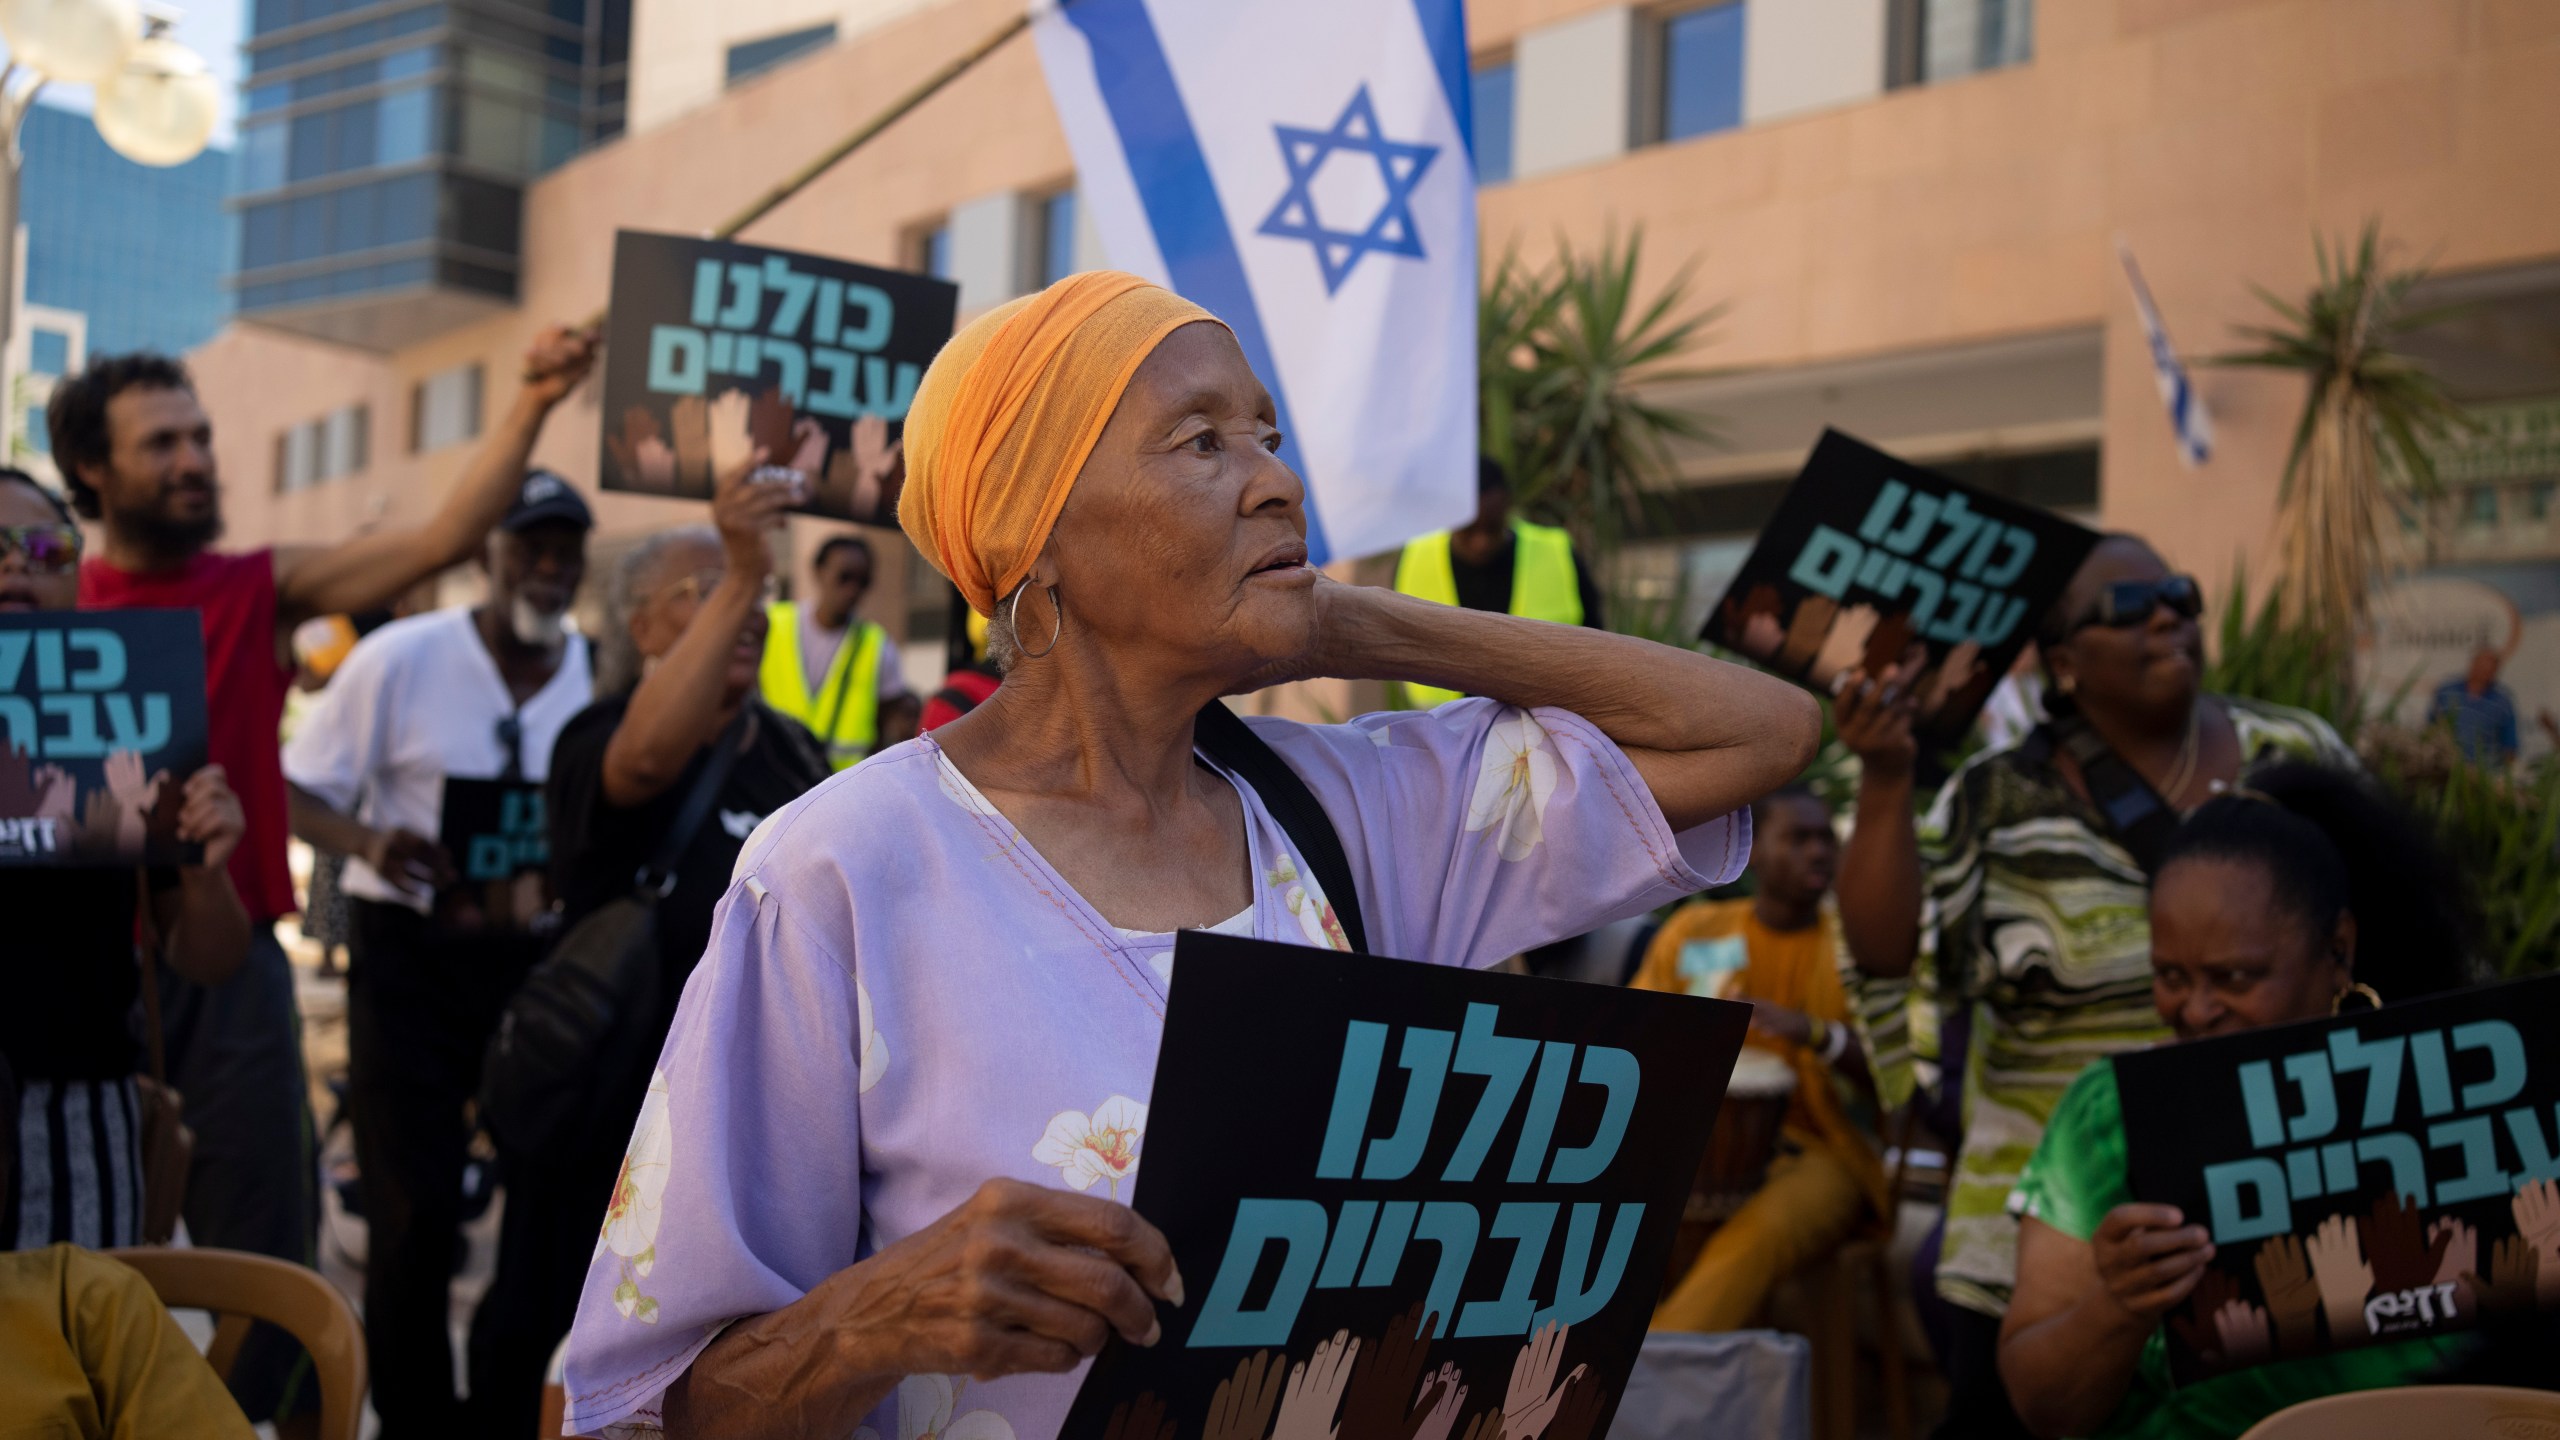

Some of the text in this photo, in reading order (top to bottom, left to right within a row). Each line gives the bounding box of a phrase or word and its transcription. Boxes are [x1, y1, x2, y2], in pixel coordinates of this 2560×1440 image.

[691, 256, 894, 352] כולנו
[647, 325, 921, 422] עבריים
[1788, 523, 2028, 647] עבריים
[1858, 477, 2037, 588] כולנו
[0, 627, 128, 692] כול
[0, 692, 171, 759] עבר
[1315, 1002, 1641, 1184] כולנו
[2237, 1018, 2528, 1150] כולנו
[1185, 1198, 1647, 1348] עבריים
